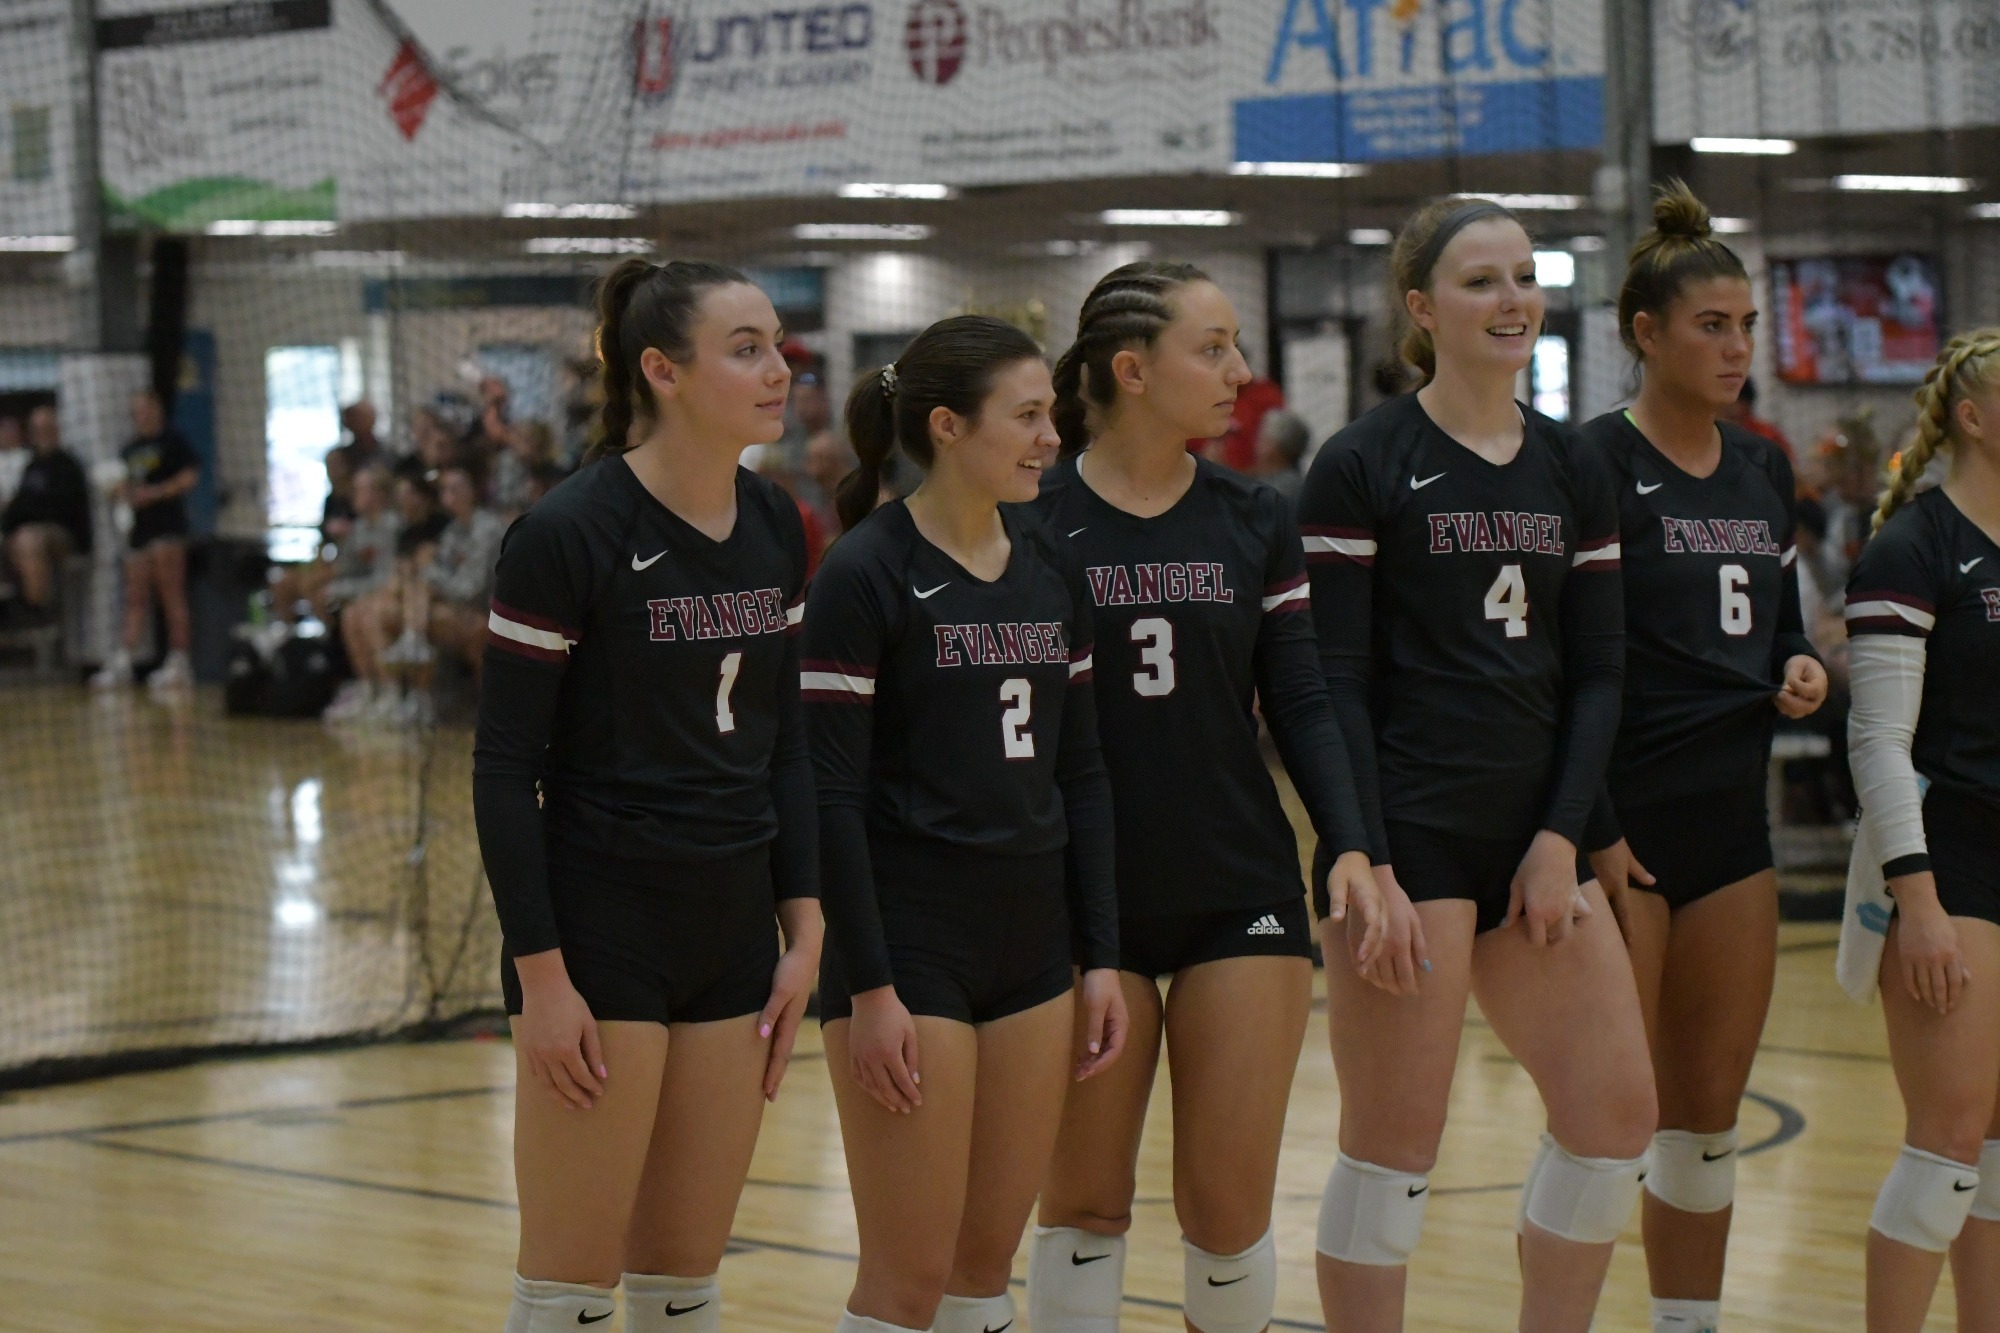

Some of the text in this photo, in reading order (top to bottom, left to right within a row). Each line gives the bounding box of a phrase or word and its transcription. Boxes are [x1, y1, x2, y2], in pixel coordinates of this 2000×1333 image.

[686, 4, 873, 63] UNITED
[1428, 511, 1565, 556] EVANGEL
[1661, 516, 1780, 556] EVANGEL
[1086, 562, 1234, 606] VANGEL
[1484, 564, 1530, 638] 4
[1718, 564, 1753, 636] 6
[647, 588, 788, 641] EVANGEL
[1130, 617, 1176, 698] 3
[715, 651, 744, 735] 1
[1000, 678, 1036, 759] 2
[1247, 925, 1285, 935] adidas
